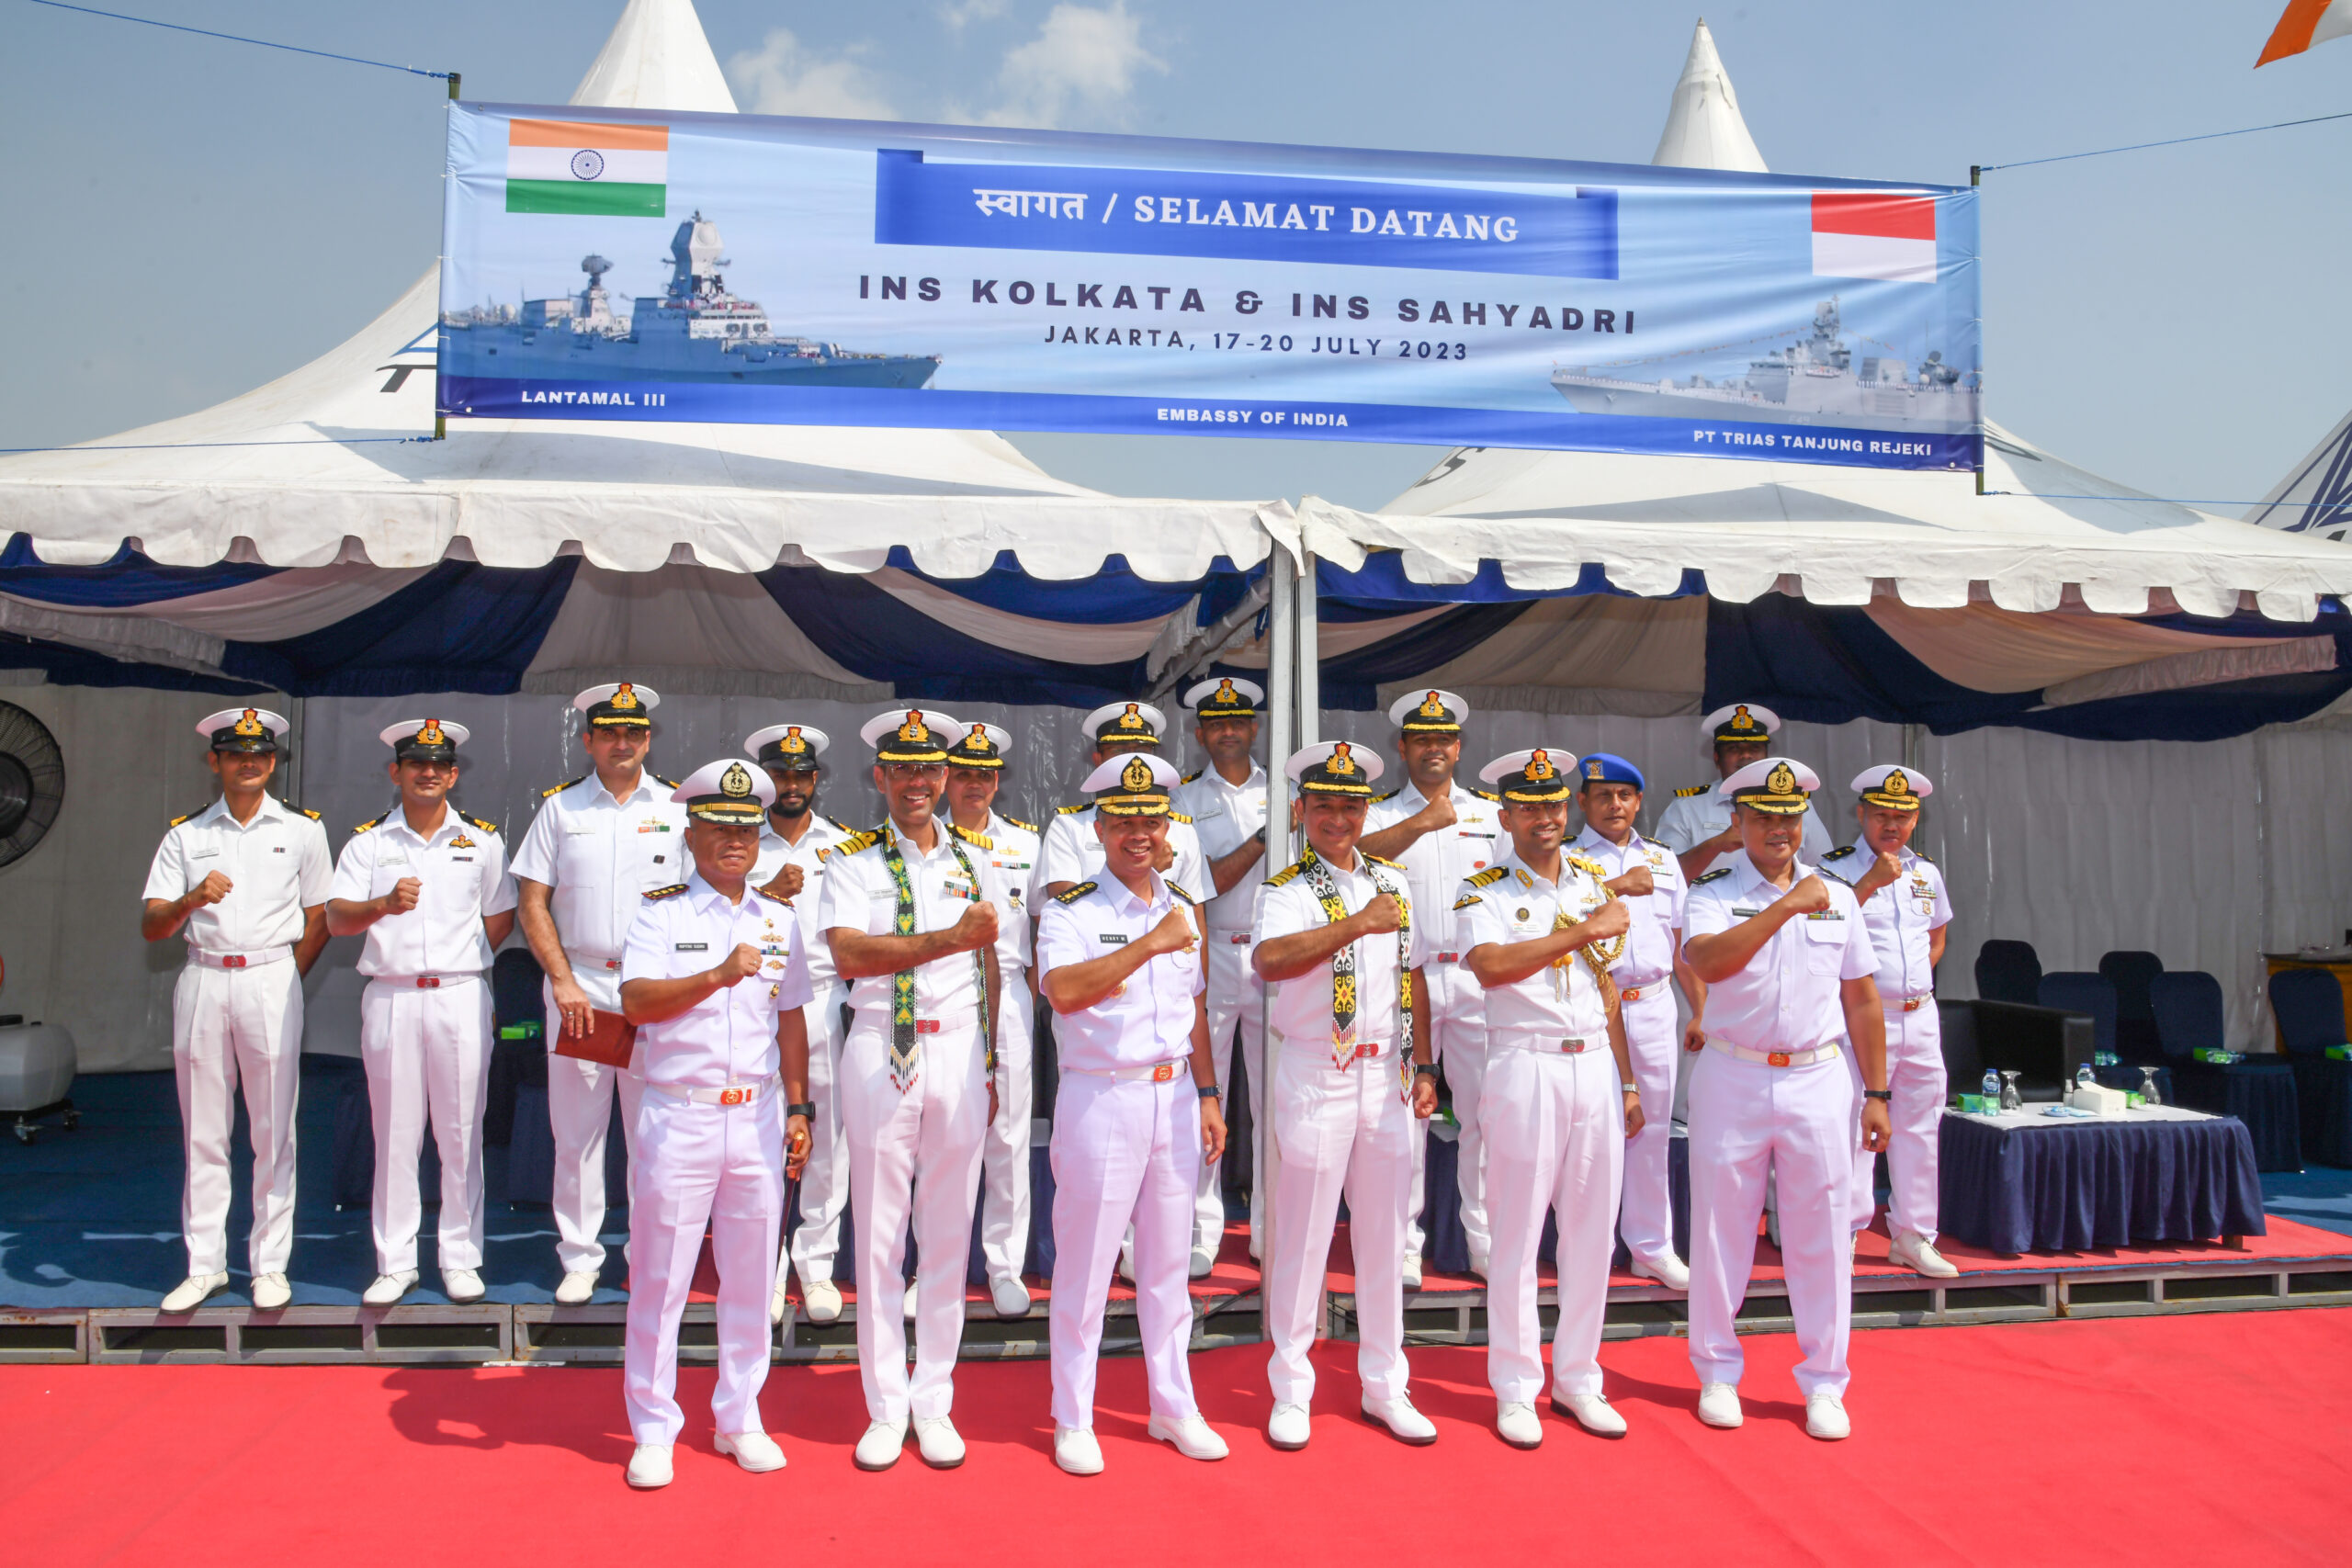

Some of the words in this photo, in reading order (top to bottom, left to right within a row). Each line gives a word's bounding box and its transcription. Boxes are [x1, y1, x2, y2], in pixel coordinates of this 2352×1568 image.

[973, 188, 1089, 220] स्वागत
[1102, 192, 1118, 224] /
[1135, 196, 1335, 231] SELAMAT
[1350, 207, 1519, 243] DATANG
[859, 275, 942, 301] INS
[972, 279, 1205, 312] KOLKATA
[1235, 290, 1263, 314] &
[1292, 292, 1370, 320] INS
[1397, 299, 1634, 334] SAHYADRI
[1045, 325, 1195, 352] JAKARTA,
[1213, 333, 1294, 352] 17-20
[1311, 336, 1382, 355] JULY
[1398, 341, 1467, 361] 2023
[521, 390, 636, 406] LANTAMAL
[644, 393, 666, 407] III
[1157, 408, 1252, 423] EMBASSY
[1260, 412, 1285, 424] OF
[1293, 412, 1349, 427] INDIA
[1693, 430, 1715, 444] PT
[1723, 432, 1775, 446] TRIAS
[1781, 435, 1863, 453] TANJUNG
[1870, 441, 1931, 457] REJEKI
